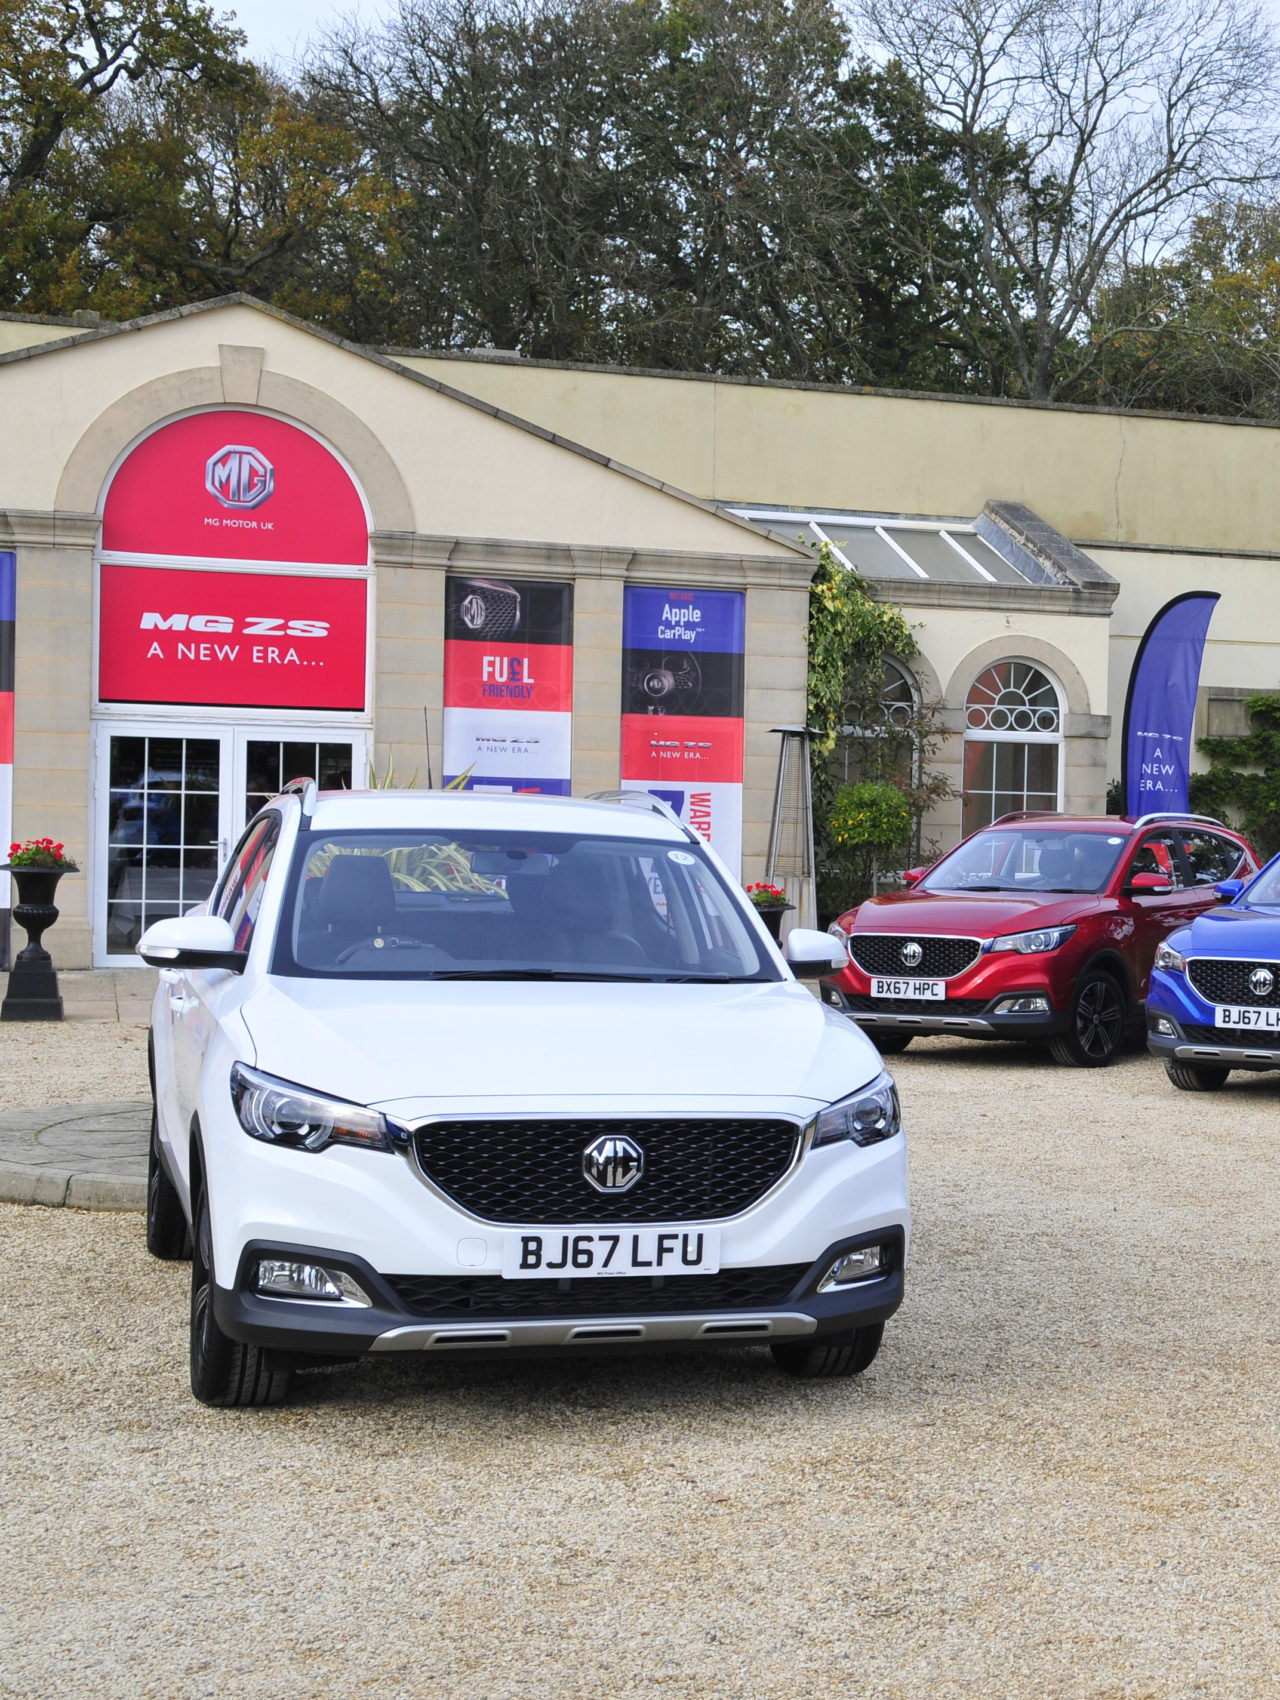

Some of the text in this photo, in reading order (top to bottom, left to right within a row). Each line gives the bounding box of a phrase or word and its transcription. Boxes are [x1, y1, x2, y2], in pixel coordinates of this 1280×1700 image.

[210, 450, 270, 506] MG
[204, 517, 274, 531] MG MOTOR UK
[139, 612, 331, 638] MG ZS
[662, 603, 701, 626] Apple
[147, 641, 164, 659] A
[177, 642, 240, 662] NEW
[482, 656, 535, 684] FU£L
[482, 683, 534, 699] FRIENDLY
[477, 745, 483, 753] A
[486, 745, 508, 753] NEW
[660, 751, 681, 759] NEW
[1153, 747, 1163, 759] A
[1141, 763, 1175, 776] NEW
[690, 792, 712, 843] WAR
[876, 980, 939, 997] BX67 HPC
[1249, 969, 1273, 994] MG
[1222, 1008, 1262, 1026] BJ67
[586, 1137, 641, 1191] MG
[519, 1232, 705, 1271] BJ67 LFU
